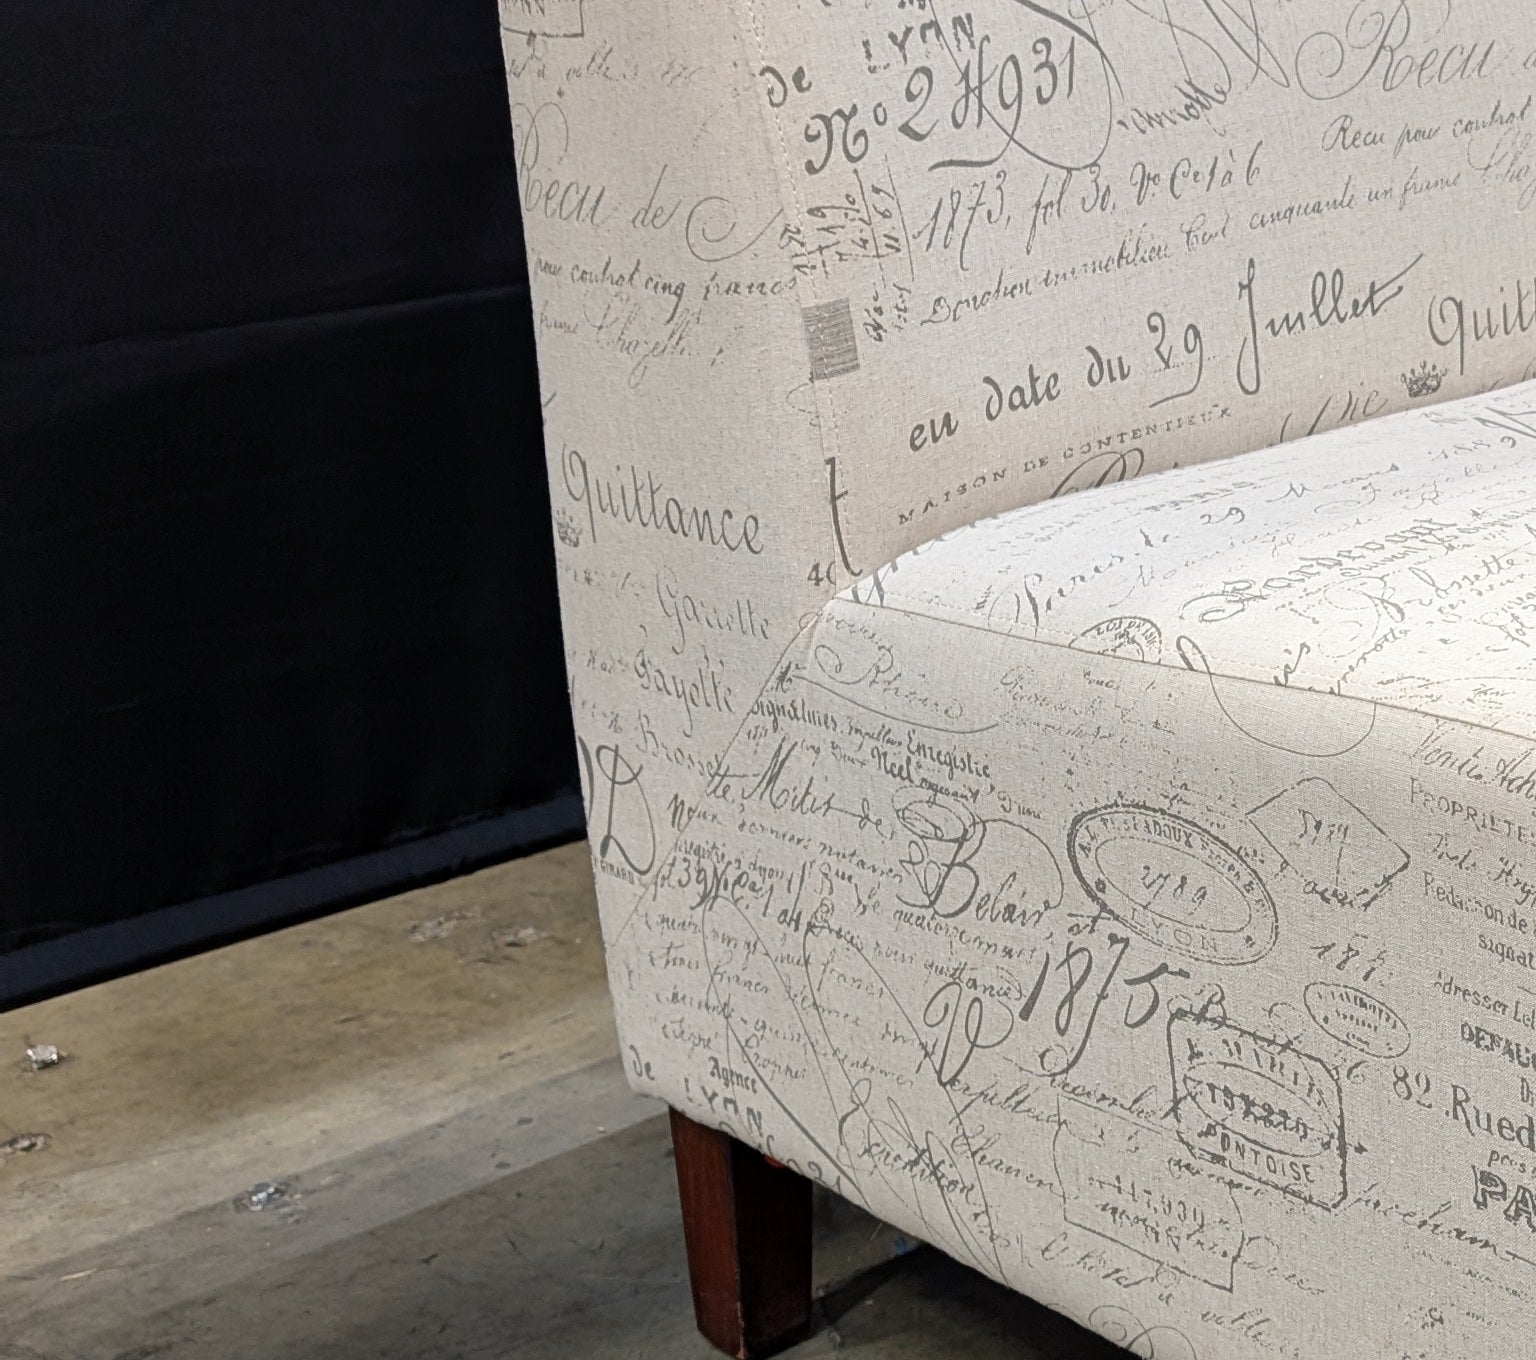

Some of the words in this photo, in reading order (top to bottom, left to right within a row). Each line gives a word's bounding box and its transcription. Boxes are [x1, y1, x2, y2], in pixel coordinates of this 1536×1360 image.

[982, 363, 1062, 422] date
[1086, 345, 1132, 388] du
[1390, 1065, 1434, 1110] 82
